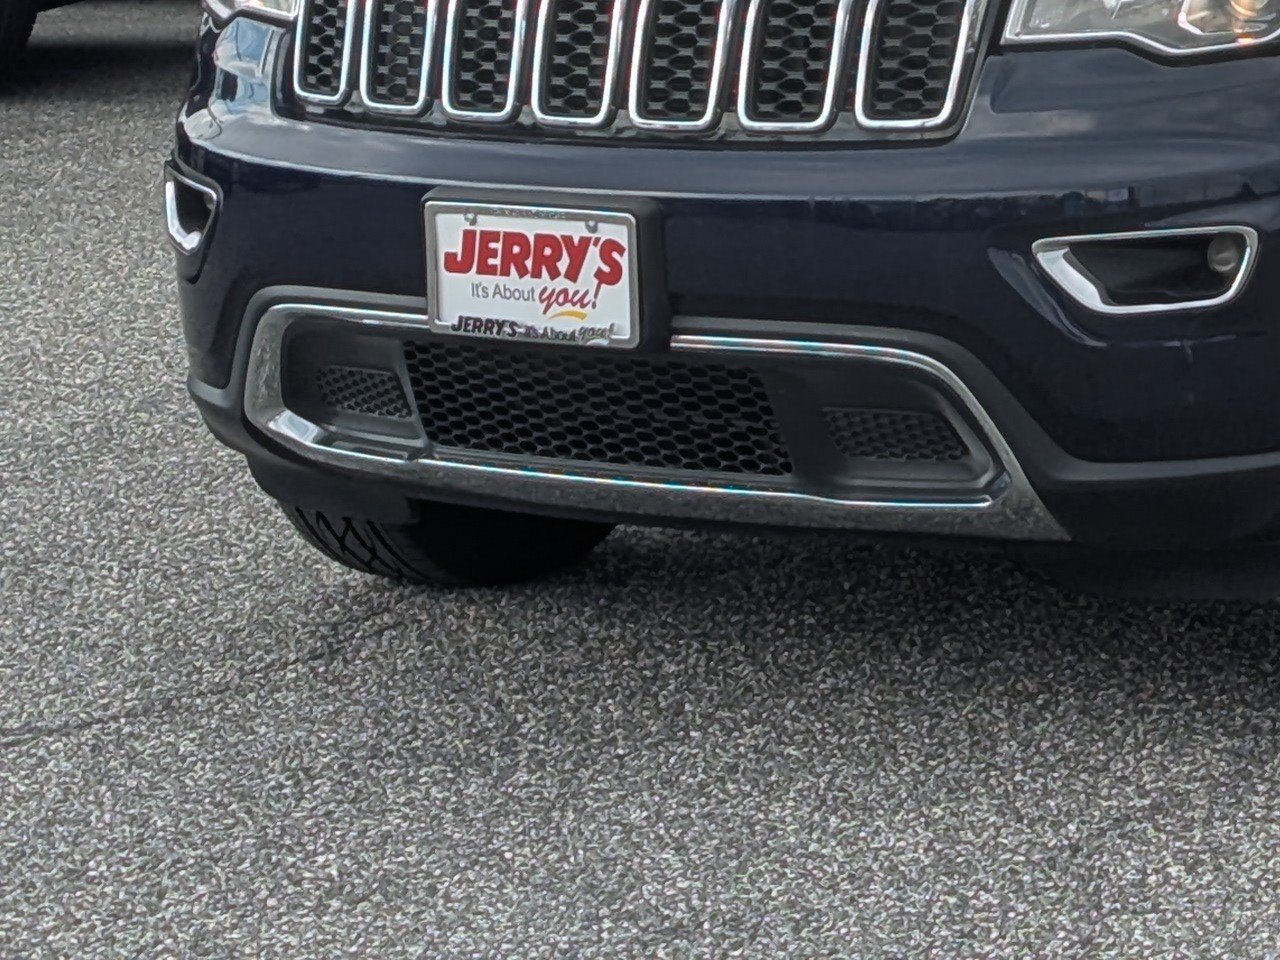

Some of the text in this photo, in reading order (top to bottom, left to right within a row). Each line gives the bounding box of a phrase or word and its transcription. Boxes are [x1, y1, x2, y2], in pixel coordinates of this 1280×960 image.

[444, 228, 627, 287] JERRY'S
[471, 282, 602, 315] It's About you!
